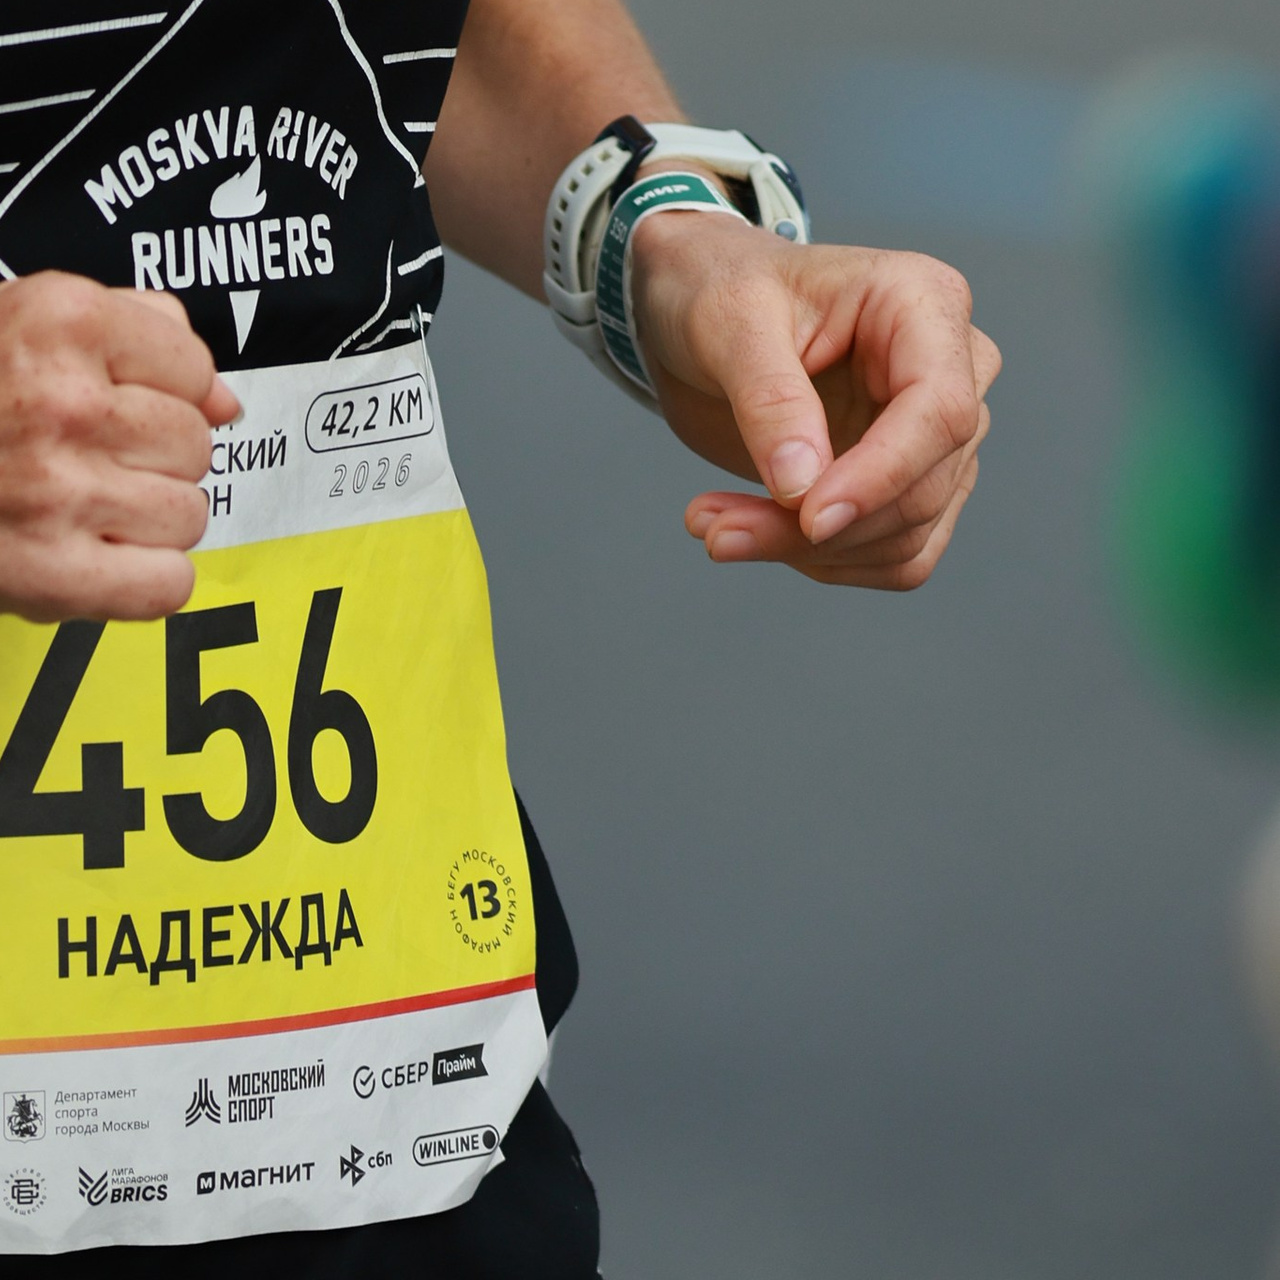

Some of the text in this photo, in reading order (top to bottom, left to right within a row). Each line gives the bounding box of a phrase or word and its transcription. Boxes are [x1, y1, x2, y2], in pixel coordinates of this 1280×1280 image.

[84, 105, 358, 225] MOSKVA RIVER
[131, 213, 335, 291] RUNNERS
[320, 396, 379, 439] 42,2
[329, 453, 412, 498] 2026
[460, 879, 501, 921] 13
[462, 849, 517, 936] МОСКОВСКИЙ
[57, 887, 364, 987] НАДЕЖДА
[450, 909, 502, 954] МАРАФОН
[228, 1059, 325, 1099] МОСКОВСКИЙ
[381, 1053, 476, 1089] СБЕР Прайм
[54, 1088, 138, 1105] Департамент
[228, 1096, 275, 1124] СПОРТ
[55, 1107, 98, 1121] спорта
[55, 1120, 150, 1137] города Москвы
[368, 1151, 393, 1170] сбп
[419, 1133, 480, 1159] WINLINE
[111, 1168, 135, 1177] ЛИГА
[111, 1174, 168, 1186] МАРАФОНОВ
[221, 1161, 315, 1191] магнит
[110, 1184, 168, 1204] BRICS
